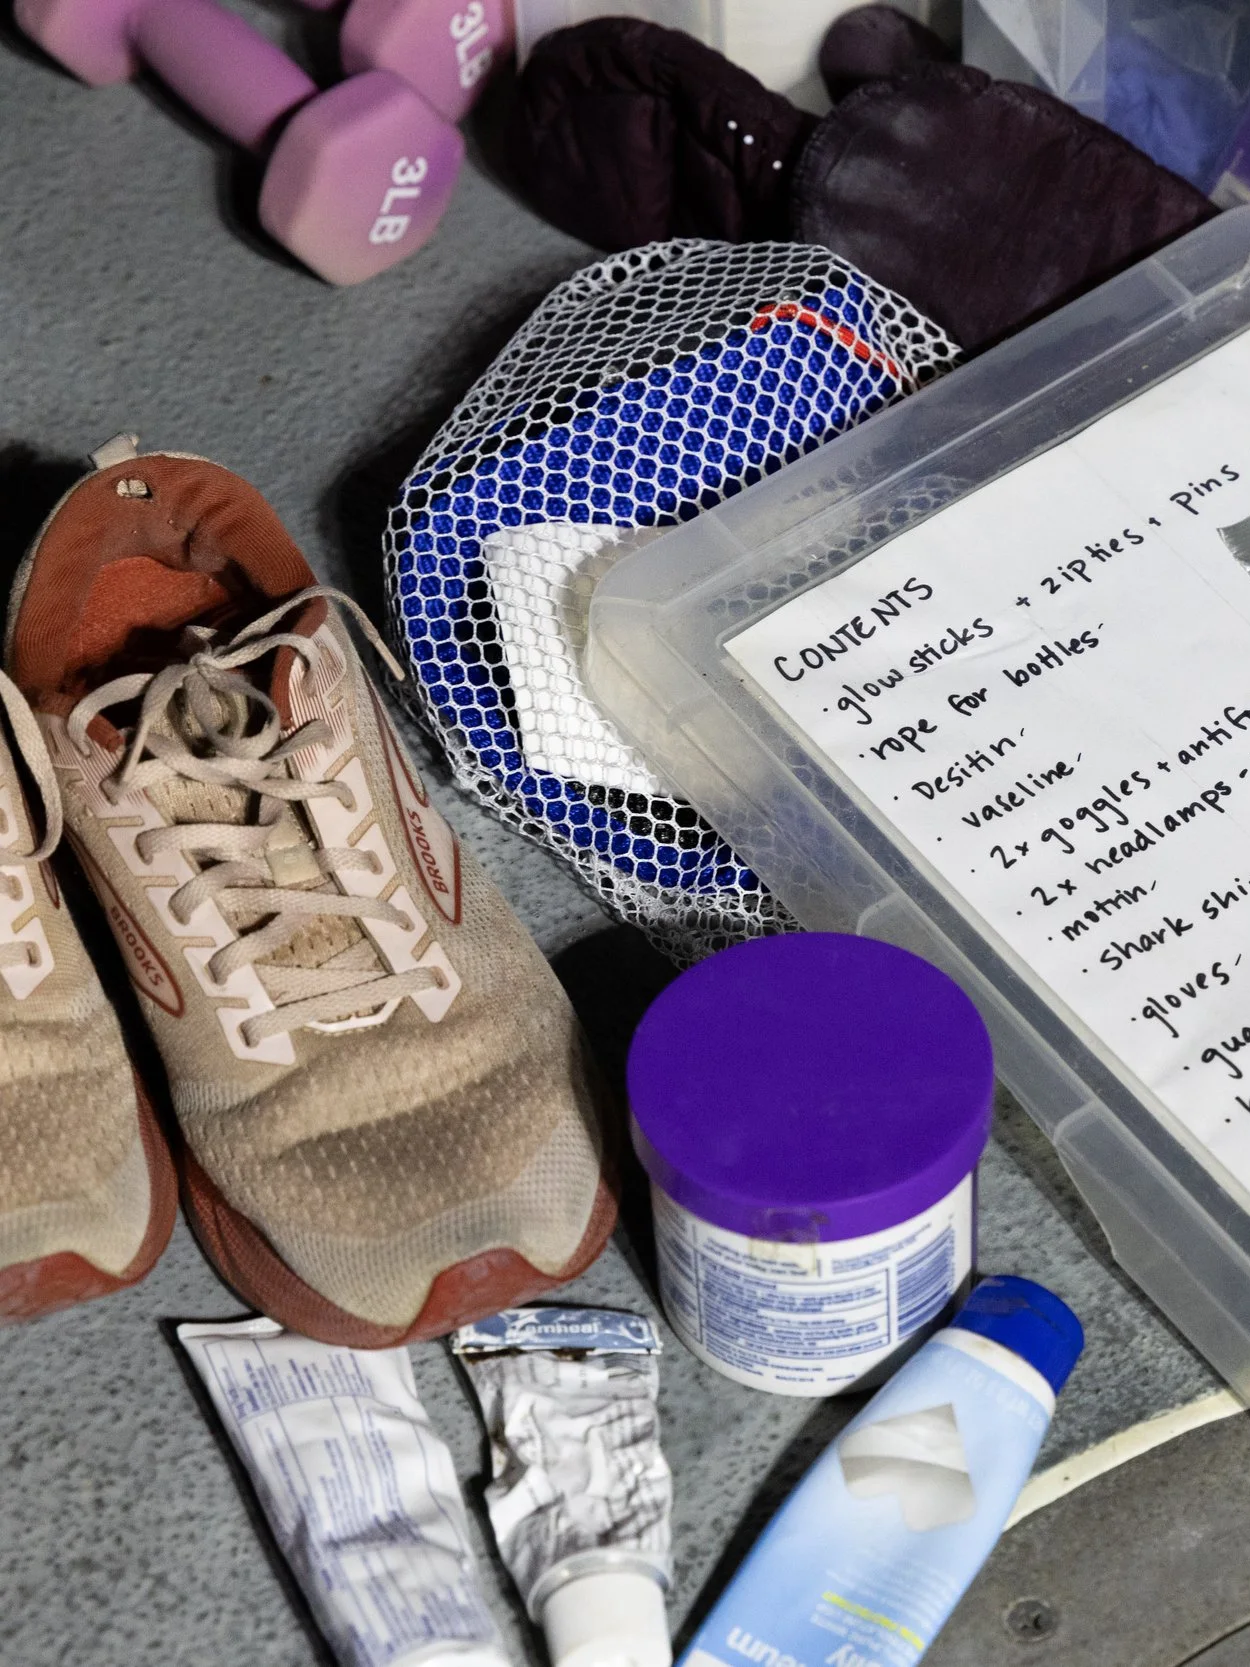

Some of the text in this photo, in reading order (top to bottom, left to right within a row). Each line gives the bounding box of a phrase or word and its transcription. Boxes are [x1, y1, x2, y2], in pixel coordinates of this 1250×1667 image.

[450, 0, 493, 89] 3LB
[368, 156, 428, 244] 3LB
[772, 576, 934, 683] CONTENTS
[836, 667, 906, 727] glow
[907, 616, 995, 675] sticks
[868, 629, 1101, 762] rope for bottles
[909, 736, 1018, 802] Desitin
[960, 760, 1076, 829] vaseline
[408, 806, 449, 896] BROOKS
[988, 840, 1031, 871] 2x
[1039, 769, 1152, 856] goggles
[1029, 877, 1079, 908] 2x
[1083, 779, 1233, 876] headlamps
[109, 904, 165, 988] BROOKS
[1060, 884, 1149, 943] motrin
[1141, 960, 1231, 1040] gloves
